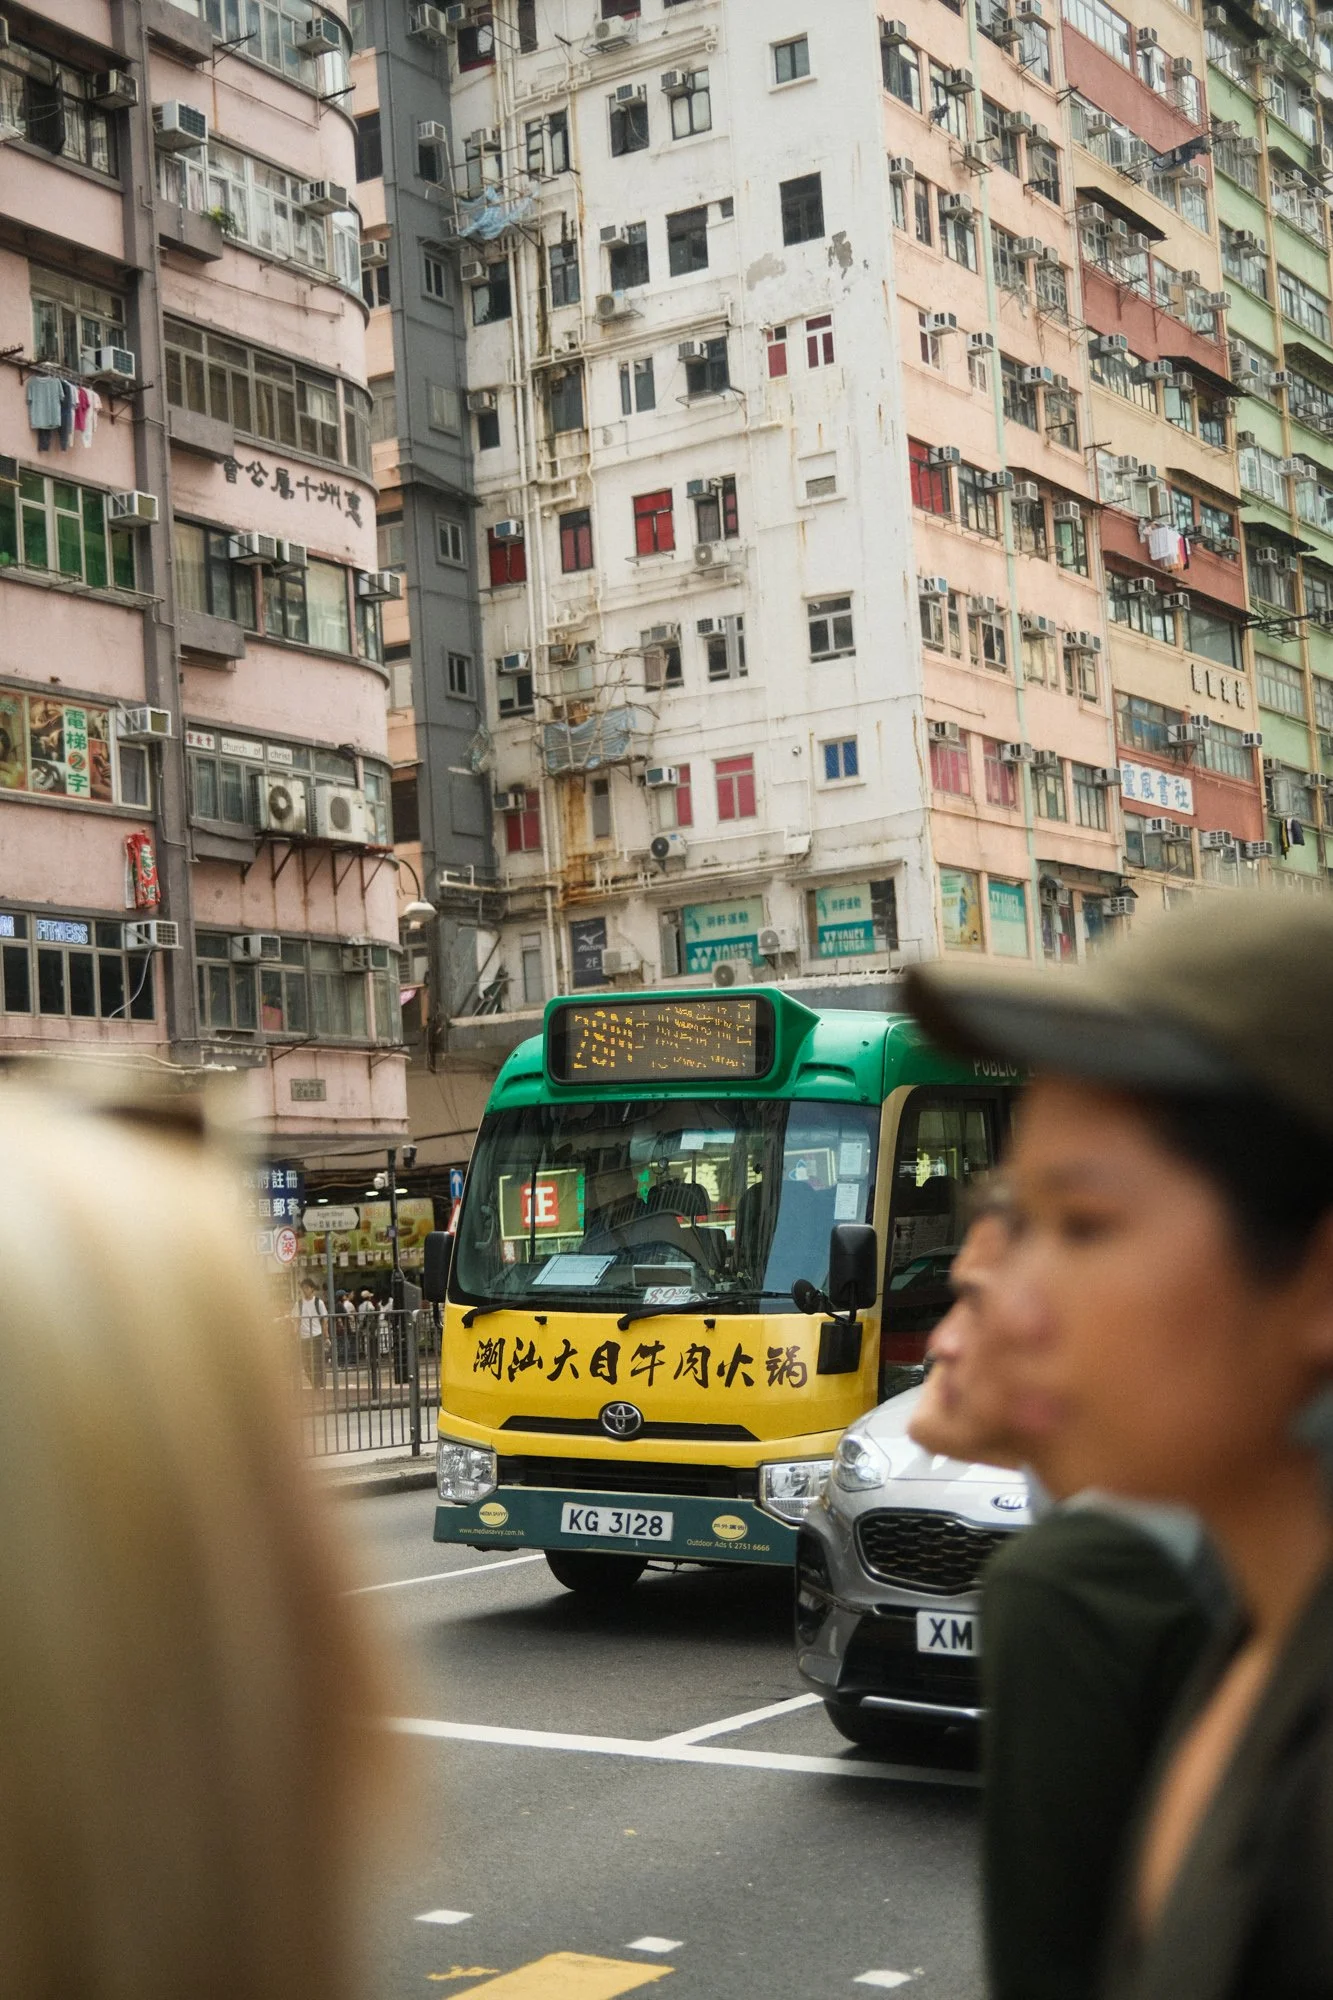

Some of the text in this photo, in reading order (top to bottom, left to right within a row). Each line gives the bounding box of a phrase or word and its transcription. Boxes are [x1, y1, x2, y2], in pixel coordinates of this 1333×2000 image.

[223, 742, 291, 759] church of christ
[36, 919, 88, 944] FITNESS
[837, 927, 865, 952] YONEX
[714, 942, 753, 962] YONEX
[585, 957, 599, 968] 2F
[973, 1057, 1018, 1077] PUBLIC
[473, 1337, 808, 1389] 潮汕大目牛肉火锅
[459, 1528, 525, 1537] www.mediasavvy.com.hk
[569, 1509, 663, 1537] KG 3128
[687, 1538, 770, 1553] Outdoor Ads 2751 6666
[929, 1617, 972, 1651] XM
